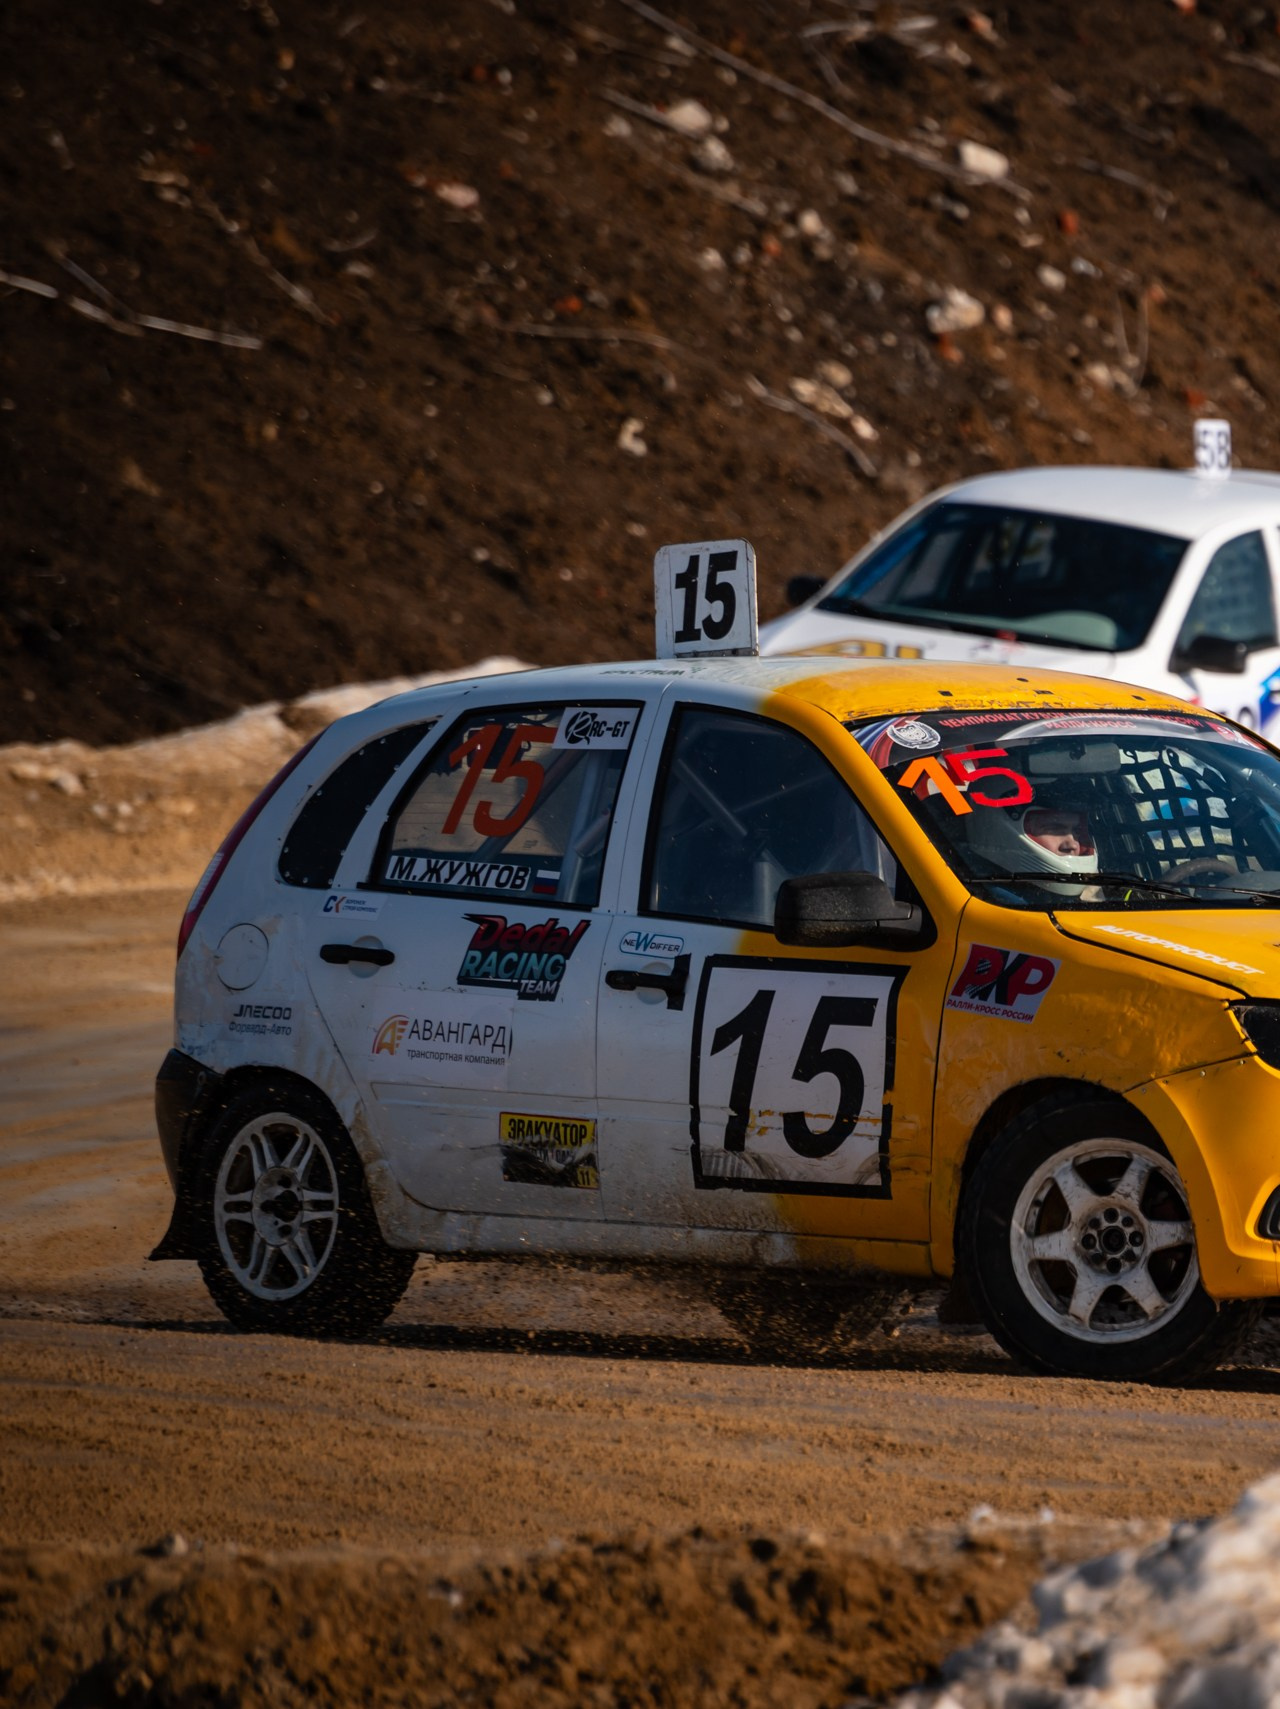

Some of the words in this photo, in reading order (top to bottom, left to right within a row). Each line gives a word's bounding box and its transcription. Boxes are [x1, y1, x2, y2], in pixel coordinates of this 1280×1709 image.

[1197, 429, 1230, 470] 58
[674, 550, 738, 644] 15
[589, 721, 630, 738] RC-GT
[938, 712, 1022, 729] ЧЕМПИОНАТ
[441, 723, 559, 838] 15
[897, 748, 1033, 816] 15
[389, 855, 530, 891] М.ЖУЖГОВ
[461, 913, 592, 952] Dedal
[1092, 925, 1265, 975] AUTOPRODUCT
[460, 949, 566, 981] RACING
[520, 979, 558, 995] TEAM
[228, 1021, 292, 1036] Форвард-Авто
[946, 999, 1001, 1016] РАЛЛИ-КРОСС
[1001, 1008, 1034, 1022] РОССИИ
[408, 1018, 507, 1055] АВАНГАРД
[407, 1048, 463, 1063] транспортная
[464, 1054, 506, 1066] компания
[710, 989, 880, 1159] 15
